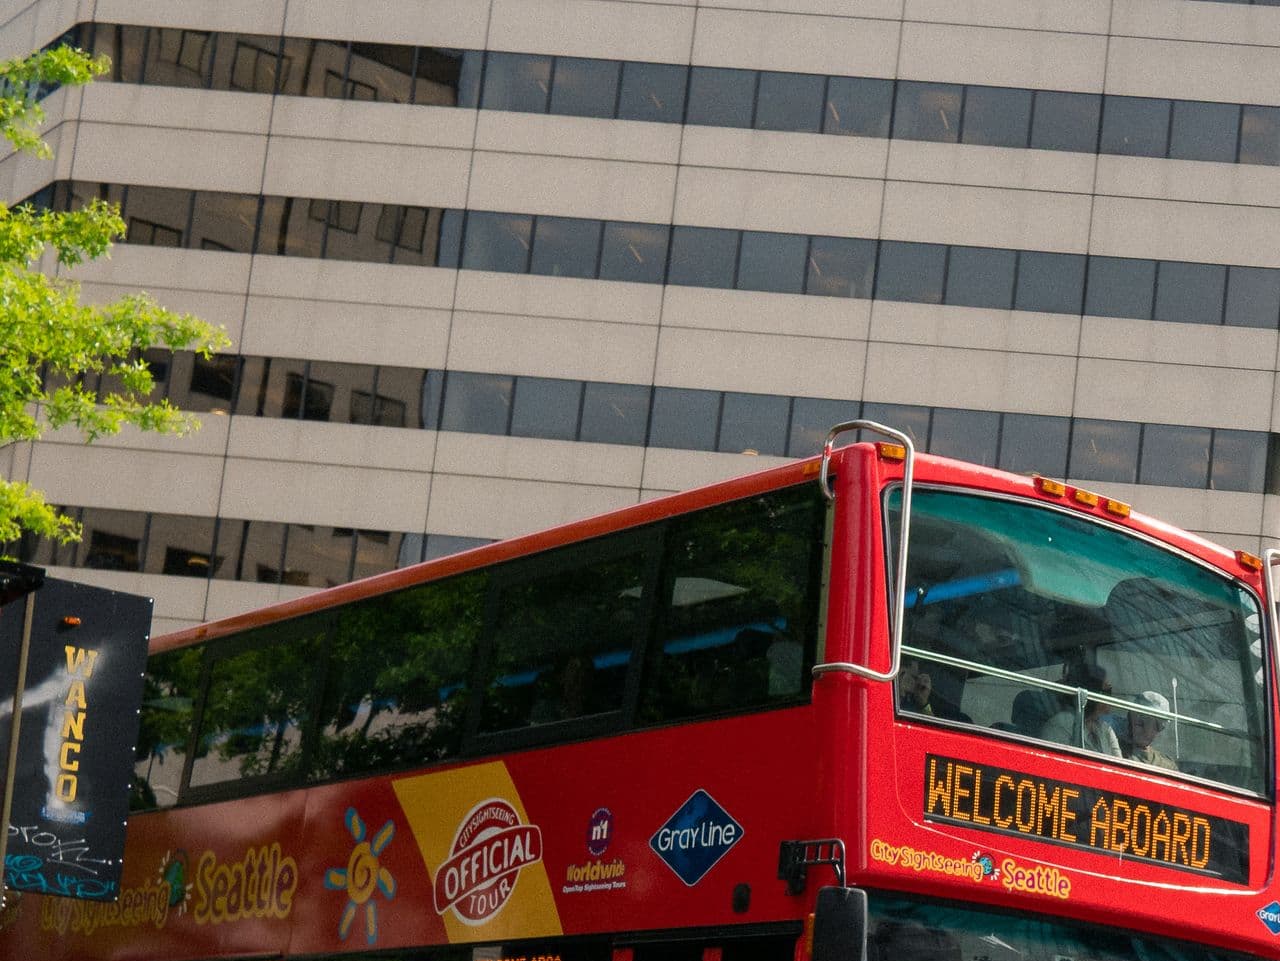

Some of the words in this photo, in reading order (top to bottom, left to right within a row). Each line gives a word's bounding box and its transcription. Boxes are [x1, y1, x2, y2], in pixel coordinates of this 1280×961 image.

[55, 645, 98, 803] WANCO
[657, 827, 700, 852] Gray
[701, 821, 735, 847] Line
[927, 758, 1079, 843] WELCOME
[1089, 796, 1211, 870] ABOARD
[195, 843, 297, 924] Seattle
[444, 831, 536, 900] OFFICIAL
[469, 877, 511, 915] TOUR
[566, 858, 626, 882] Worldwide
[870, 839, 900, 865] City
[900, 846, 984, 882] Sightseeing
[1002, 858, 1072, 900] Seattle
